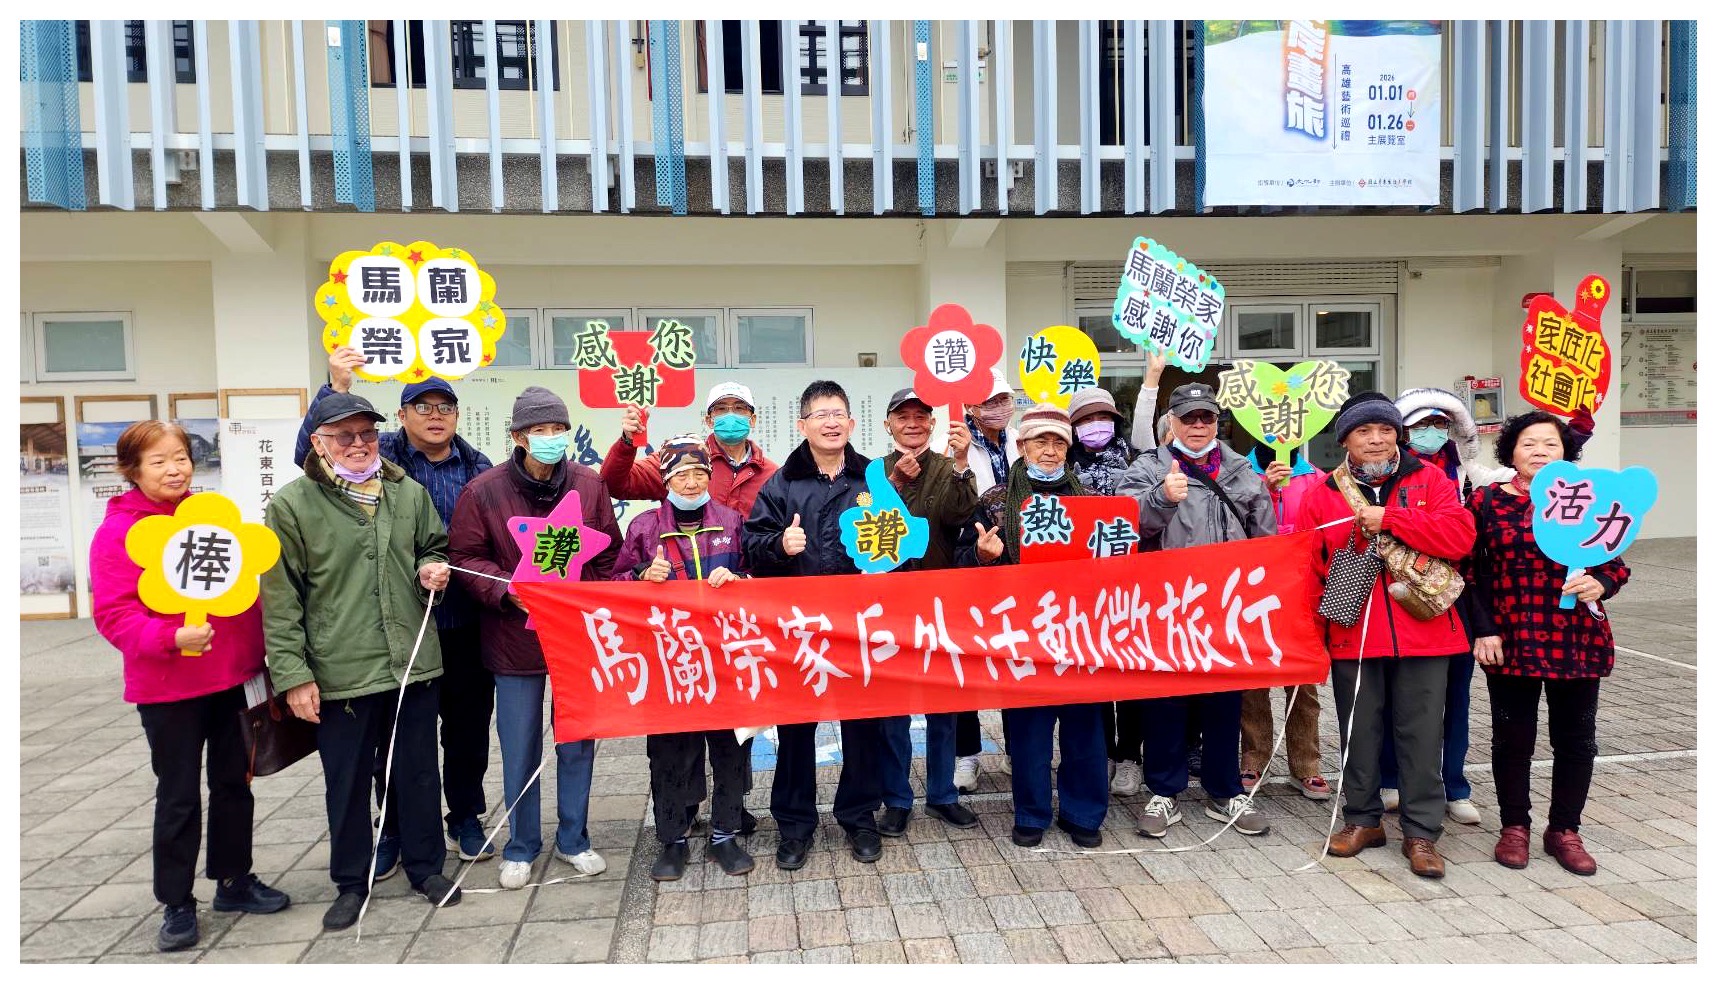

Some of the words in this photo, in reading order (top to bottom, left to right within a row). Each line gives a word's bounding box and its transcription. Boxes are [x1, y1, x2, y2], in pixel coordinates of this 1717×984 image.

[1368, 85, 1403, 101] 01.01
[1380, 74, 1395, 82] 2026
[1368, 114, 1403, 131] 01.26
[361, 266, 468, 304] 馬蘭
[1126, 249, 1222, 327] 馬蘭榮家
[362, 327, 472, 365] 榮家
[1122, 296, 1204, 360] 感謝你
[1538, 316, 1602, 373] 家庭化
[932, 338, 970, 375] 讚
[1021, 336, 1096, 394] 快樂
[1530, 359, 1595, 411] 社會化
[259, 440, 274, 520] 花東百大
[854, 508, 907, 563] 讚
[1022, 495, 1139, 559] 熱情
[1545, 480, 1632, 552] 活力
[175, 530, 232, 591] 棒
[533, 524, 581, 579] 讚
[581, 565, 1282, 705] 馬蘭榮家戶外活動微旅行
